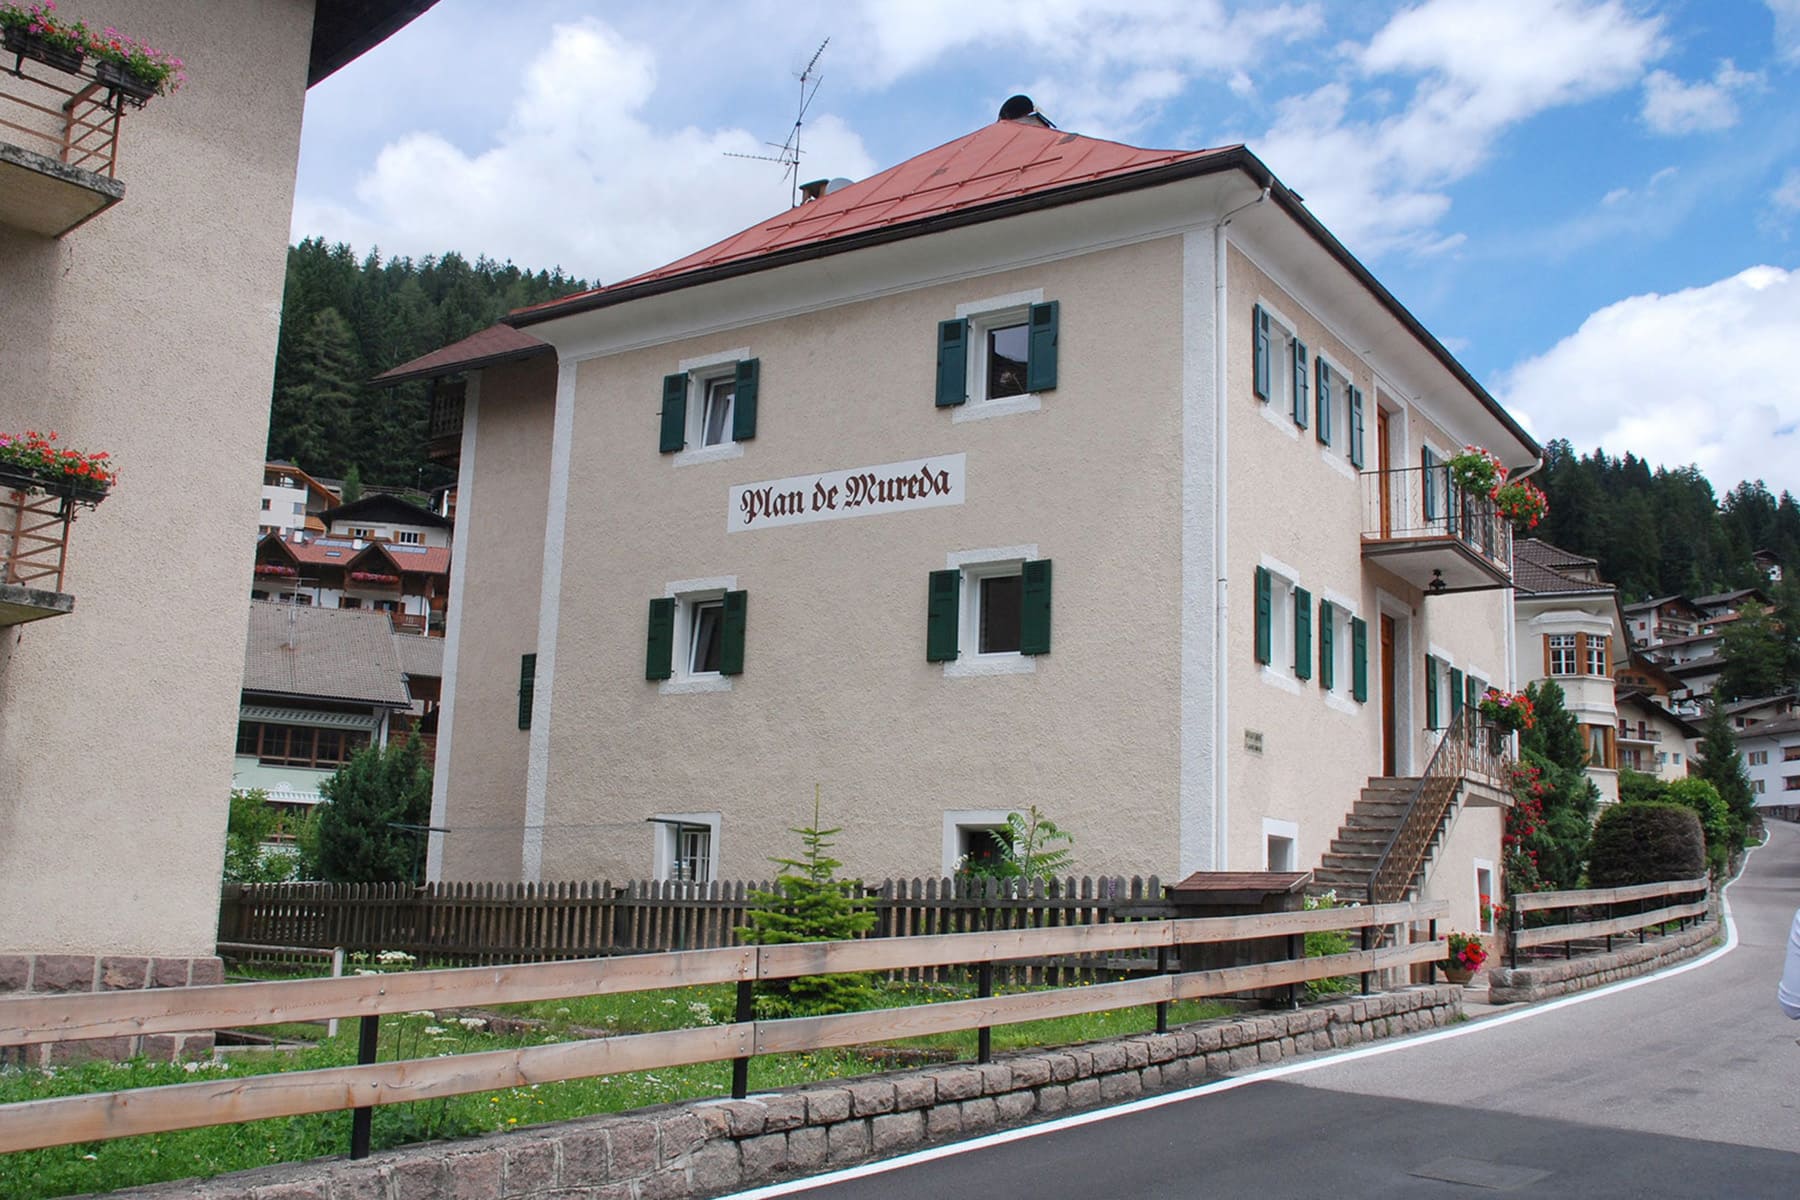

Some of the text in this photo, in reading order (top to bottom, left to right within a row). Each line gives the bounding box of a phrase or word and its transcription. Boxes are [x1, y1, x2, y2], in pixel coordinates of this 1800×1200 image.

[740, 464, 952, 524] Plan de Mureda
